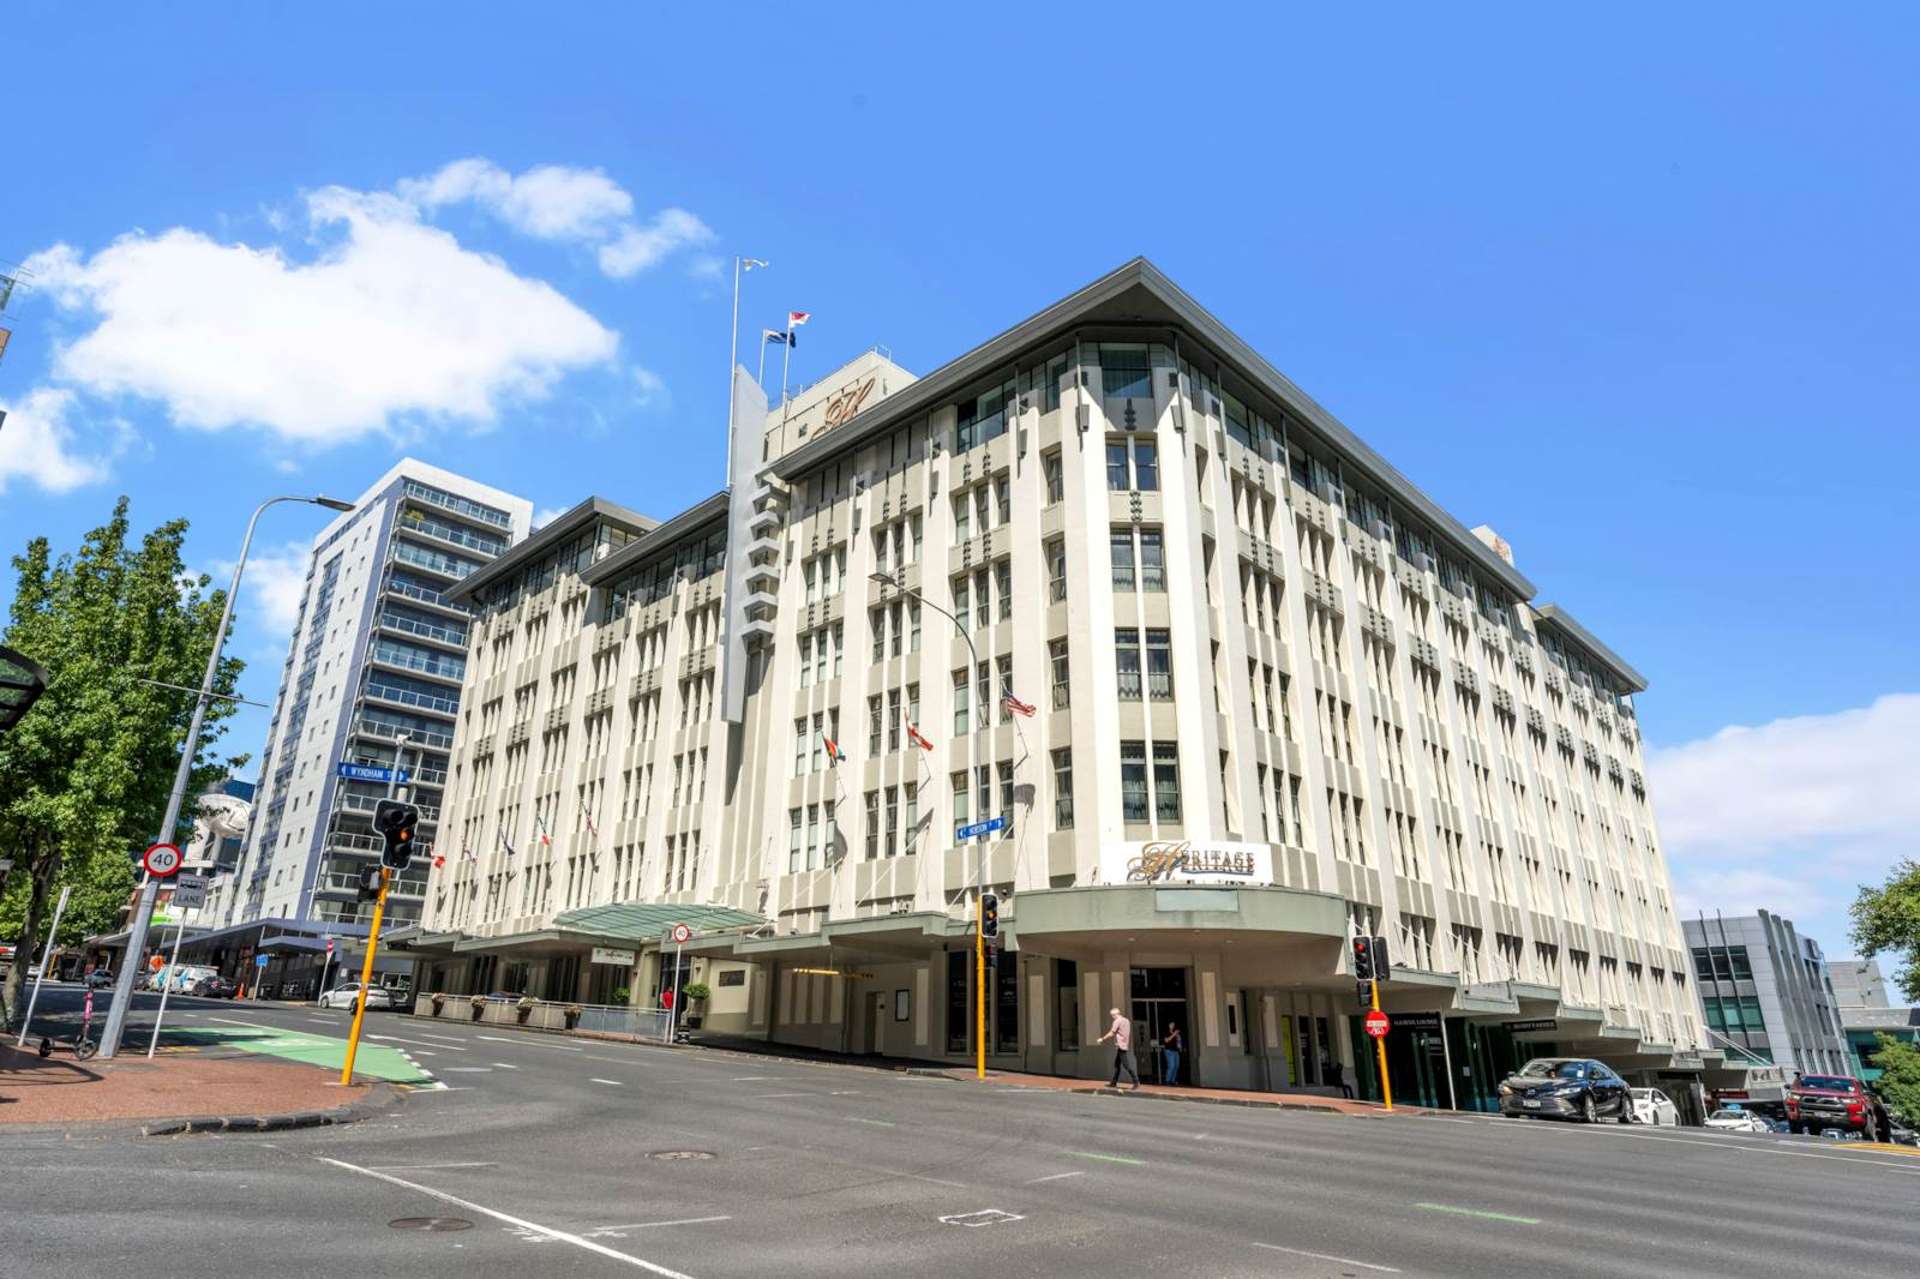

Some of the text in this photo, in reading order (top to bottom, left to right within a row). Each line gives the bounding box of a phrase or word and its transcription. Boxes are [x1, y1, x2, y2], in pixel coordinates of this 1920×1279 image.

[351, 767, 384, 779] WYNDHAM
[153, 853, 174, 866] 40
[1127, 840, 1255, 882] HERITAGE
[179, 893, 201, 903] LANE
